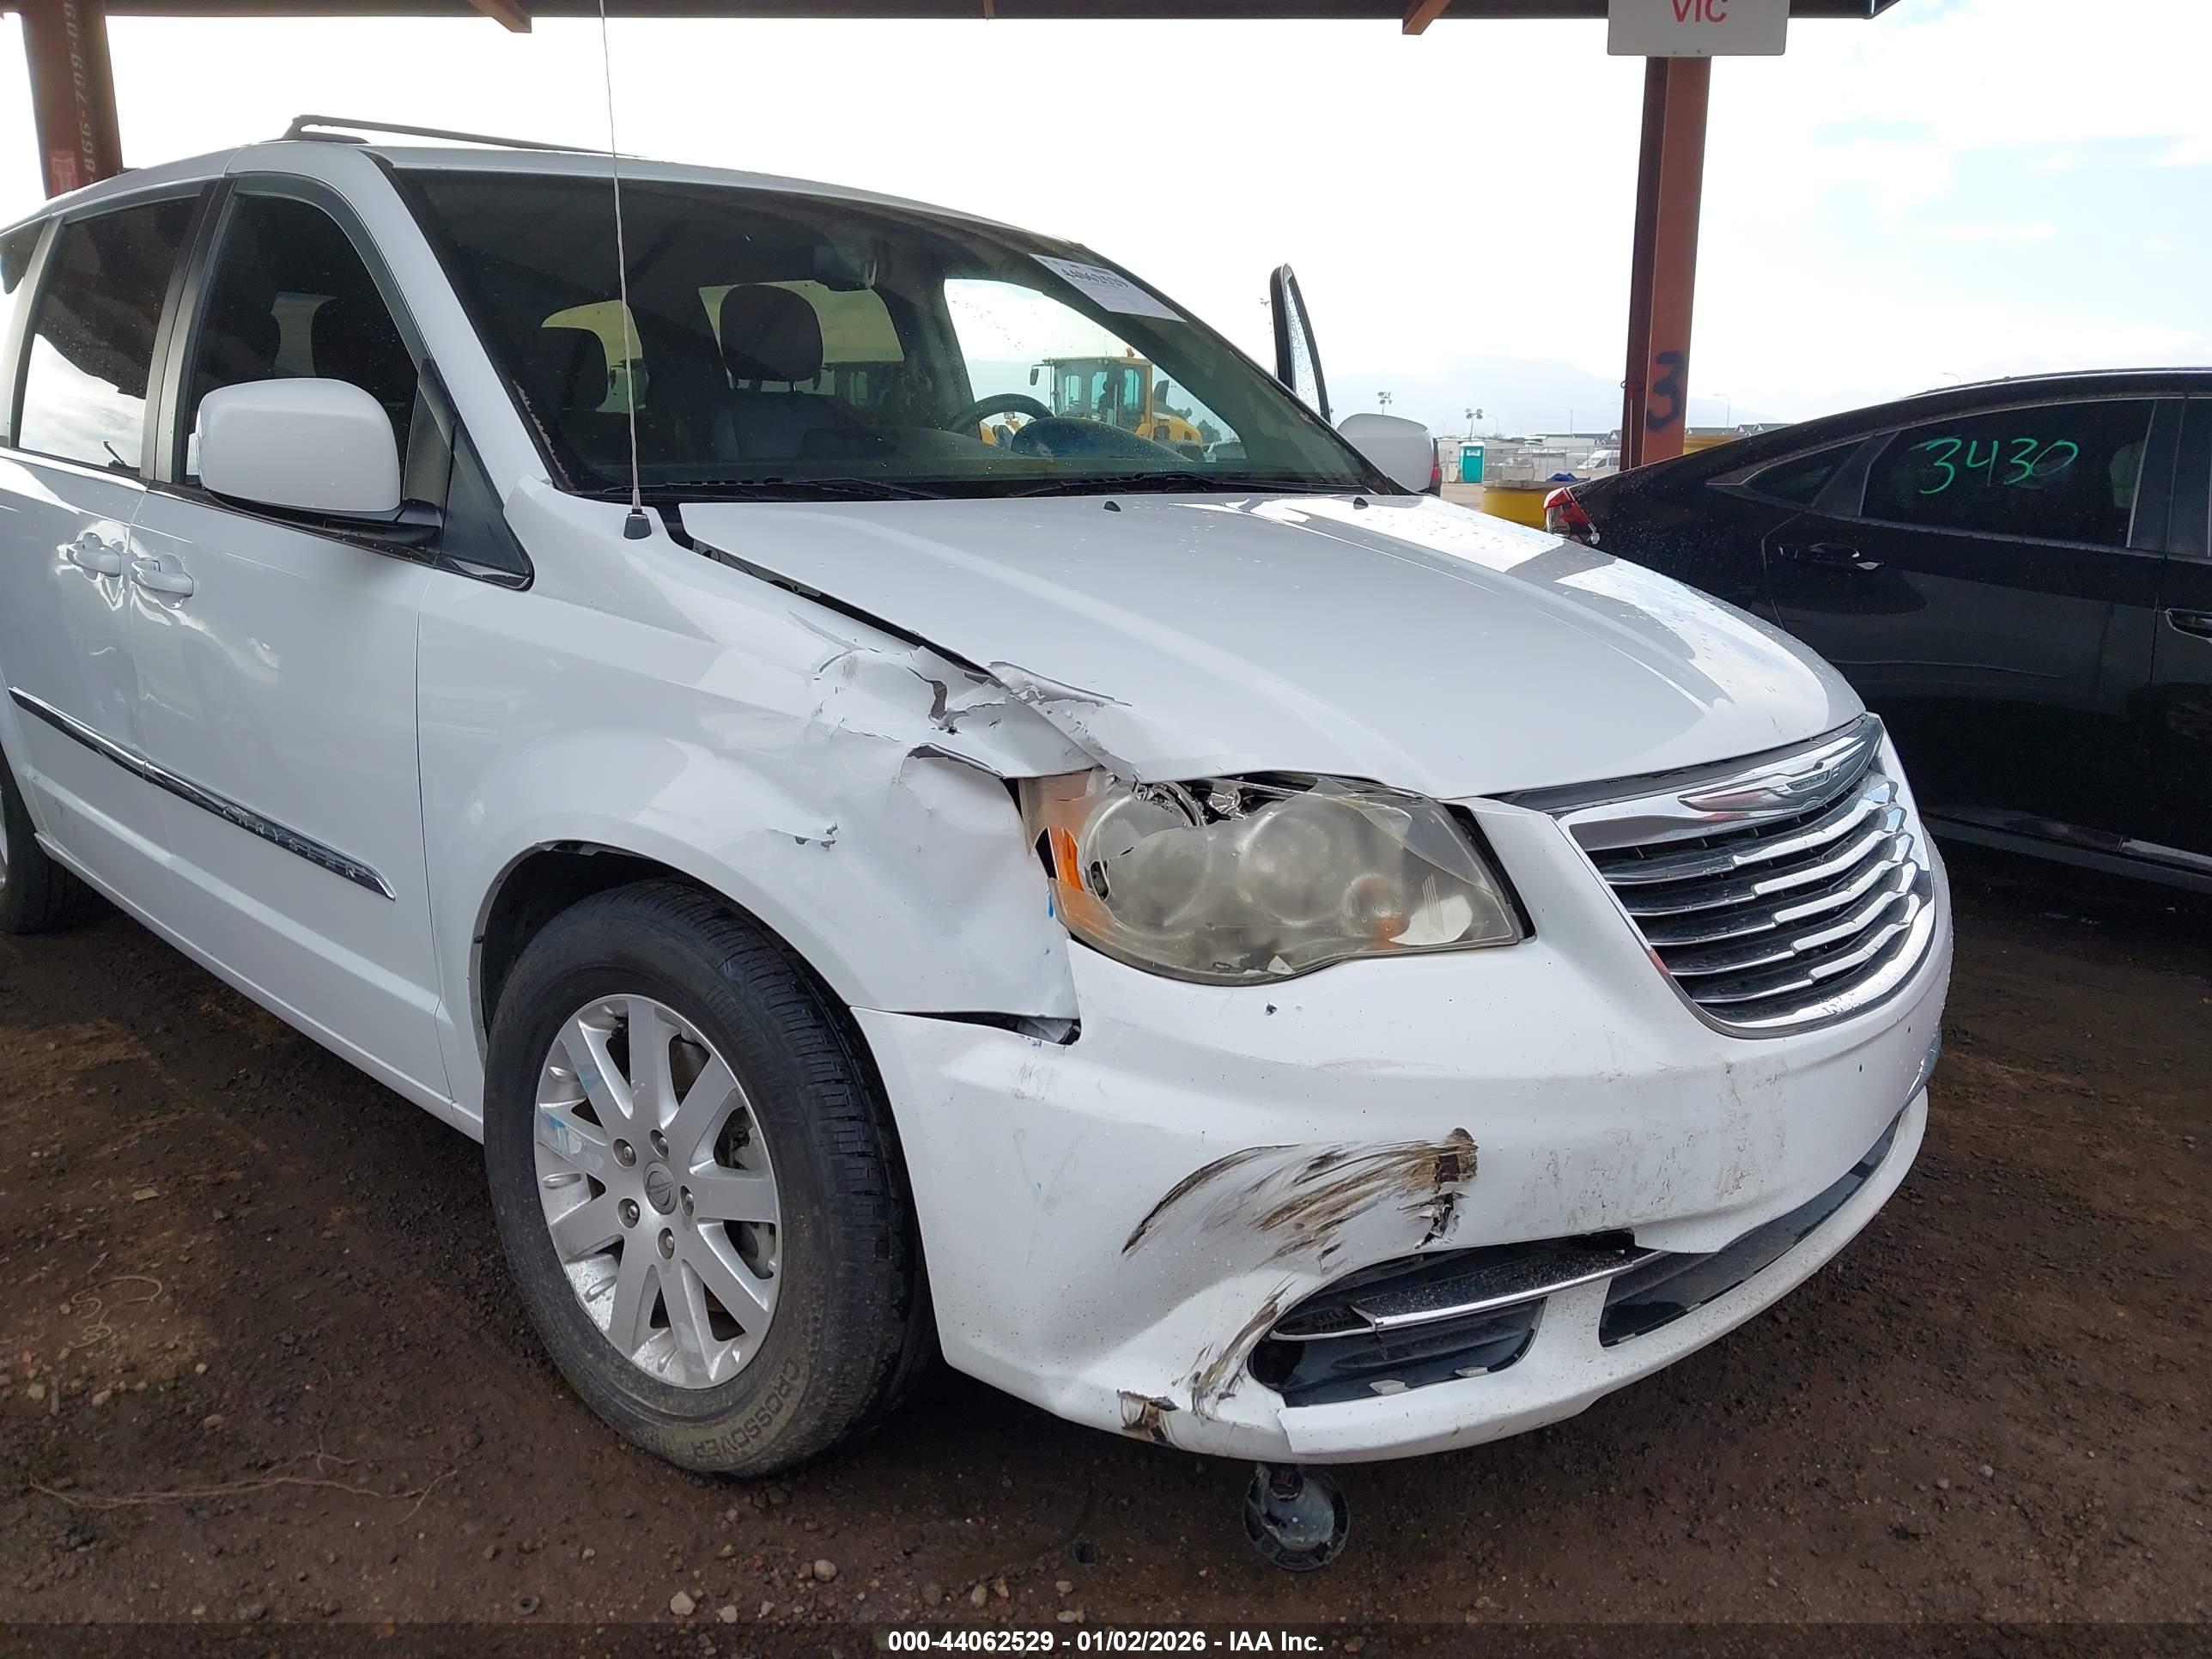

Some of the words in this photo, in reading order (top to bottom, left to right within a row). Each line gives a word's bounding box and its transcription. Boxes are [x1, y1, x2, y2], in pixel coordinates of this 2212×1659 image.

[1671, 0, 1727, 22] VIC
[1645, 350, 1686, 432] 3
[1918, 437, 2080, 495] 3430
[690, 1358, 801, 1458] CROSSOVER
